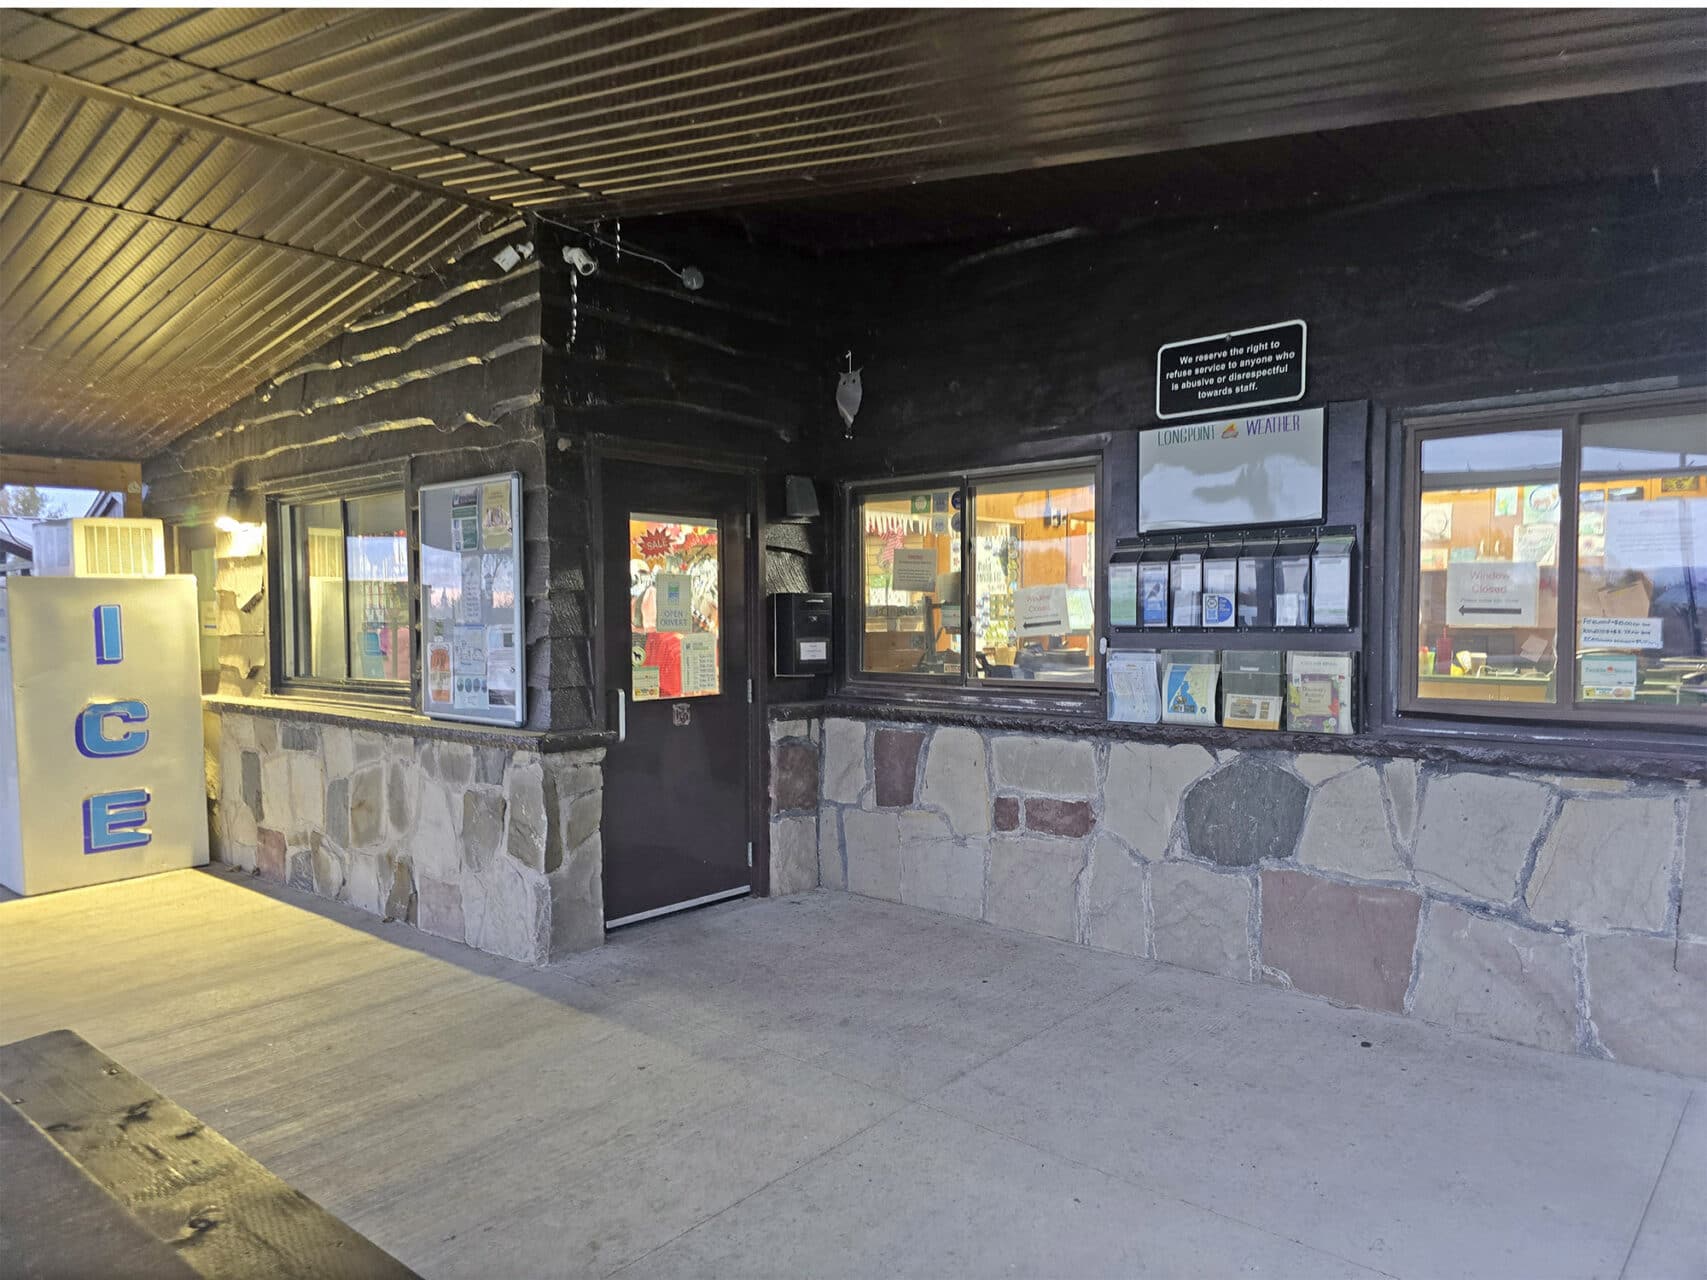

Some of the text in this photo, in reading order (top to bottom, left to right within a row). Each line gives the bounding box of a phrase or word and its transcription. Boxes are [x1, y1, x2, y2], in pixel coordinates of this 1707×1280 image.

[1180, 340, 1280, 365] We reserve the right to
[1166, 350, 1296, 380] refuse service to anyone who
[1171, 364, 1289, 391] is abusive or disrespectful
[1198, 382, 1258, 400] towards staff.
[1246, 414, 1300, 437] WEATHER
[646, 540, 669, 551] SALE
[663, 609, 684, 618] OPEN
[74, 604, 153, 854] ICE
